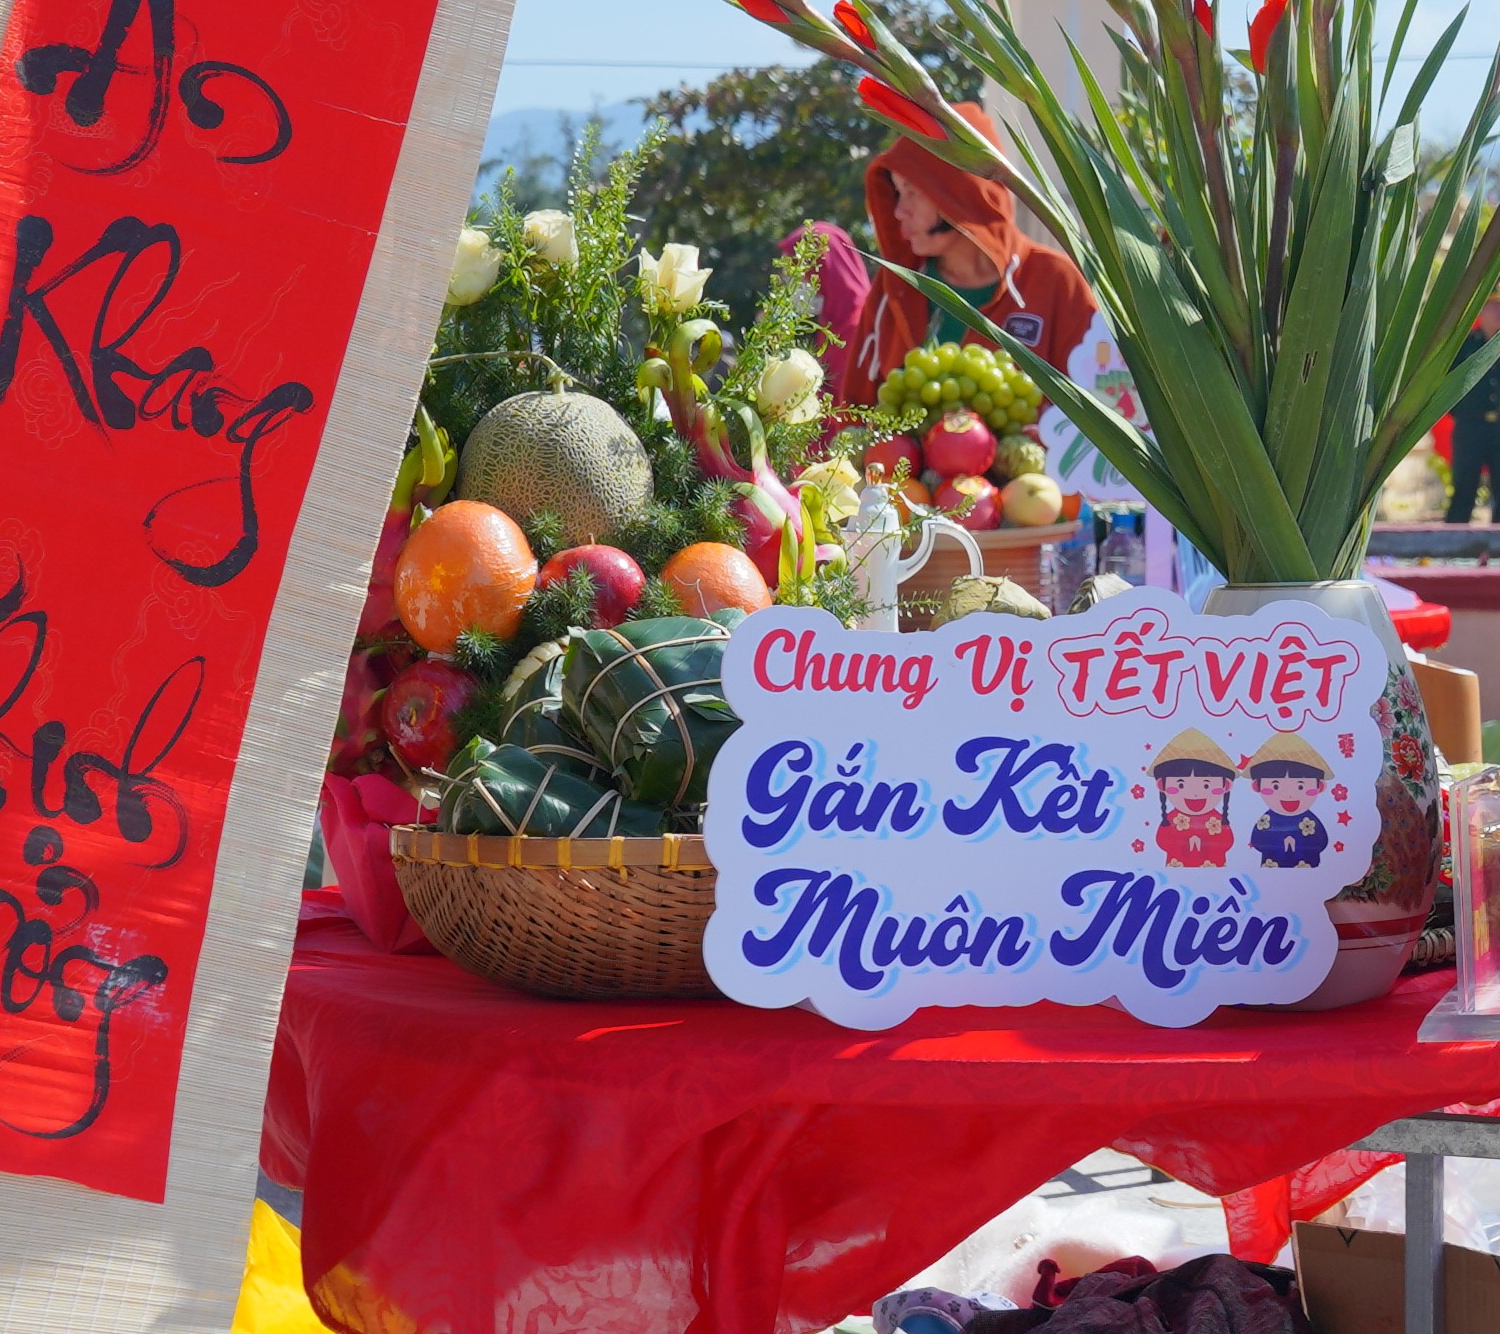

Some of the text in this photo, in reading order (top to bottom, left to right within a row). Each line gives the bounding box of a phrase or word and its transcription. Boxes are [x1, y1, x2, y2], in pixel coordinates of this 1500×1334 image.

[753, 621, 1348, 719] Chung Vị TẾT VIỆT
[740, 735, 1114, 849] Gắn Kết
[740, 867, 1296, 992] Muôn Miền
